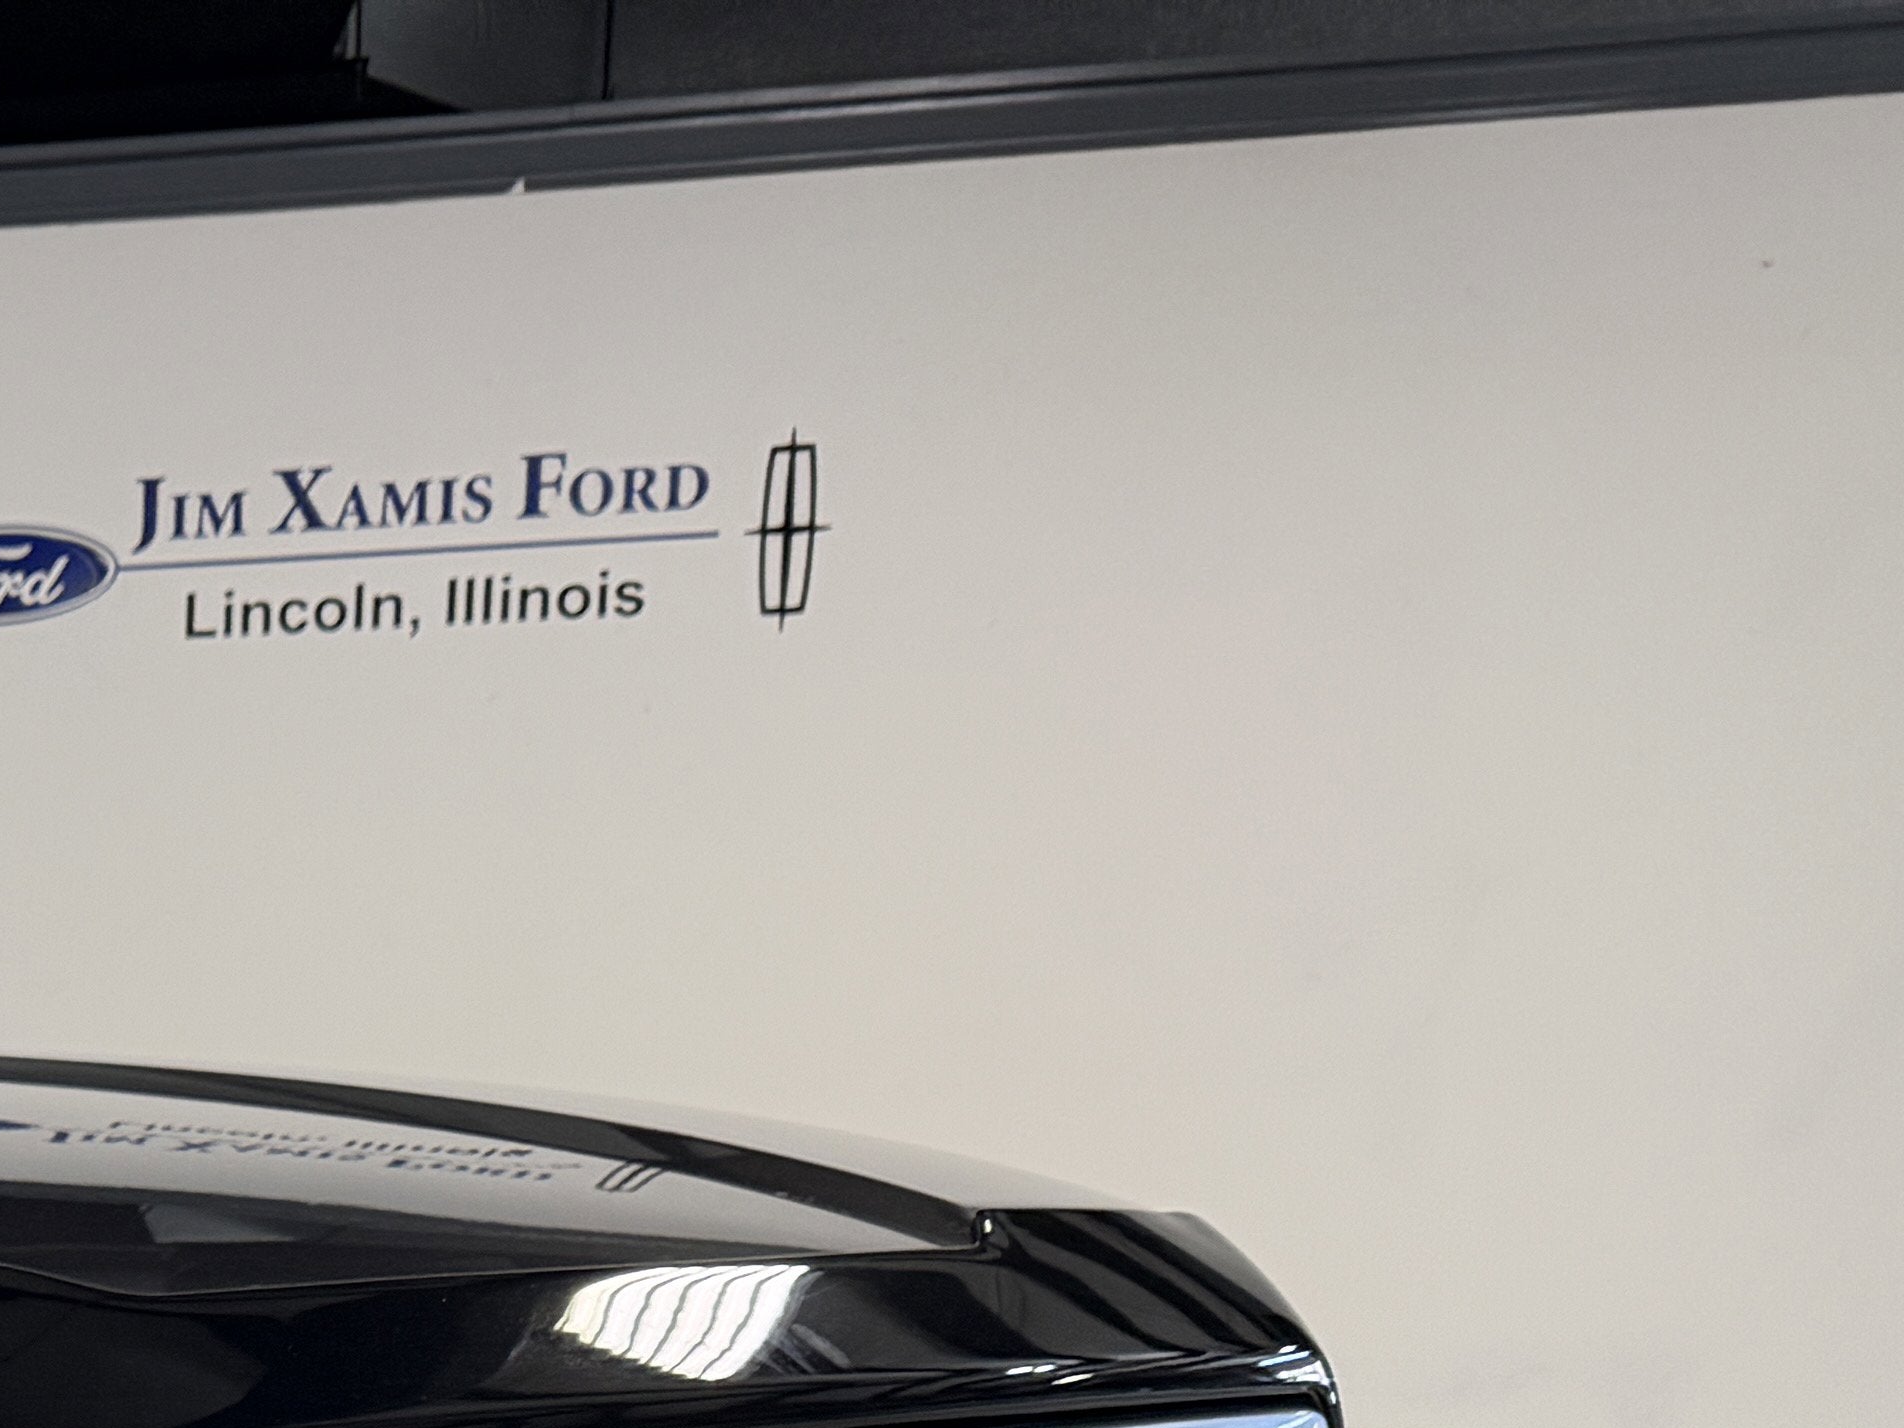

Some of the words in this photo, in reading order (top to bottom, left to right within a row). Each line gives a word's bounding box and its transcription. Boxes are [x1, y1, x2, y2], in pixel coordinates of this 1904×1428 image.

[133, 477, 245, 554] JIM
[270, 466, 492, 534] XAMIS
[518, 453, 709, 519] FORD
[186, 584, 419, 638] Lincoln,
[446, 571, 644, 625] Illinois
